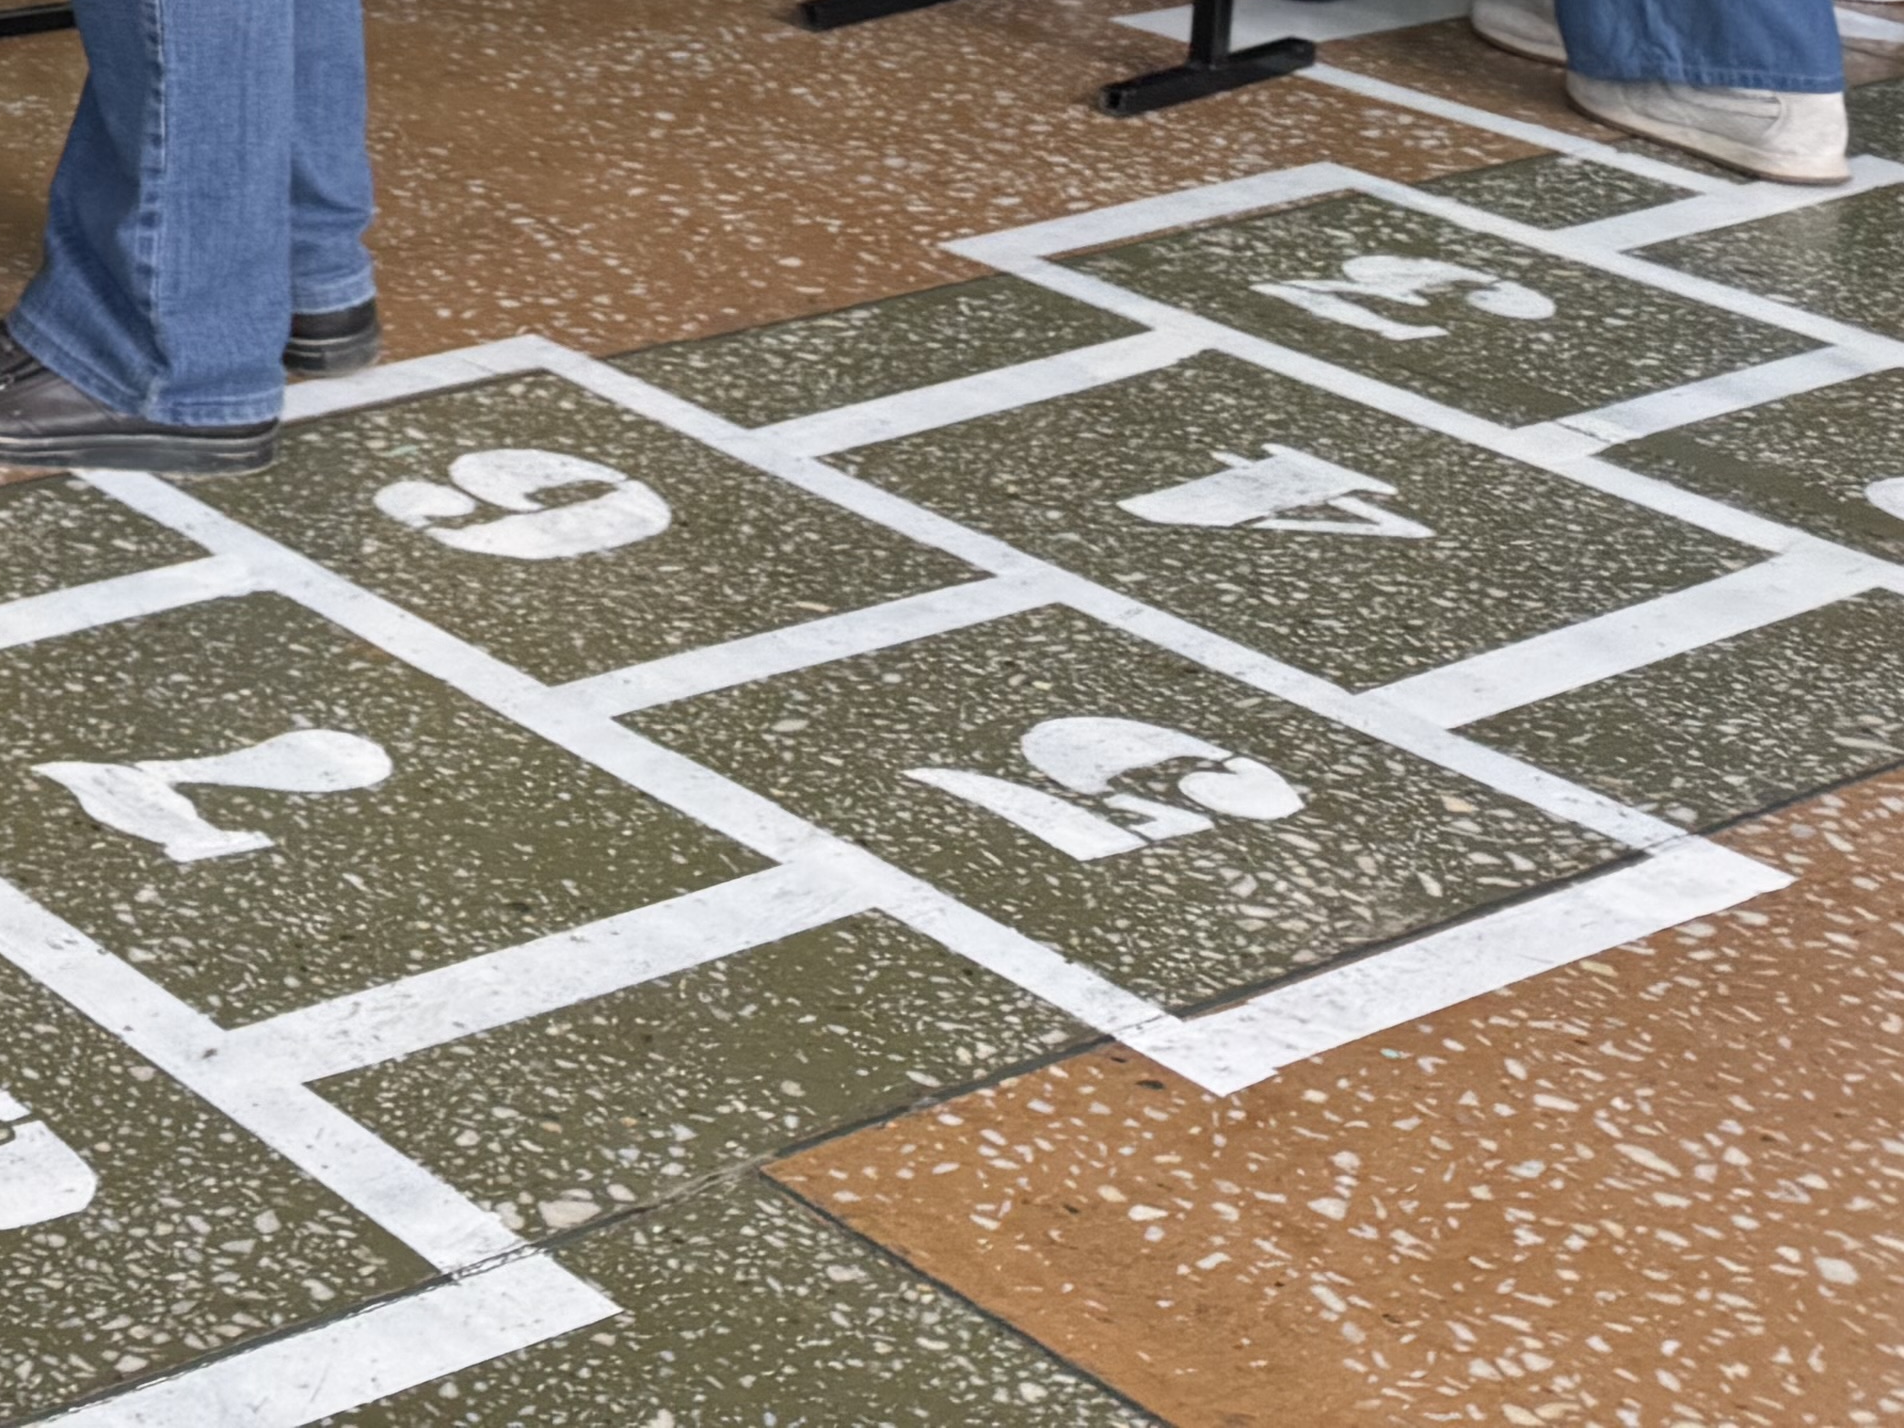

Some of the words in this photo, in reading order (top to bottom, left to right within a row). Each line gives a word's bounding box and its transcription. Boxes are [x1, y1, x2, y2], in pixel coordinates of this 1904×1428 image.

[374, 449, 672, 560] 6
[1117, 443, 1435, 540] 4
[30, 728, 393, 864] 7
[902, 716, 1310, 862] 5
